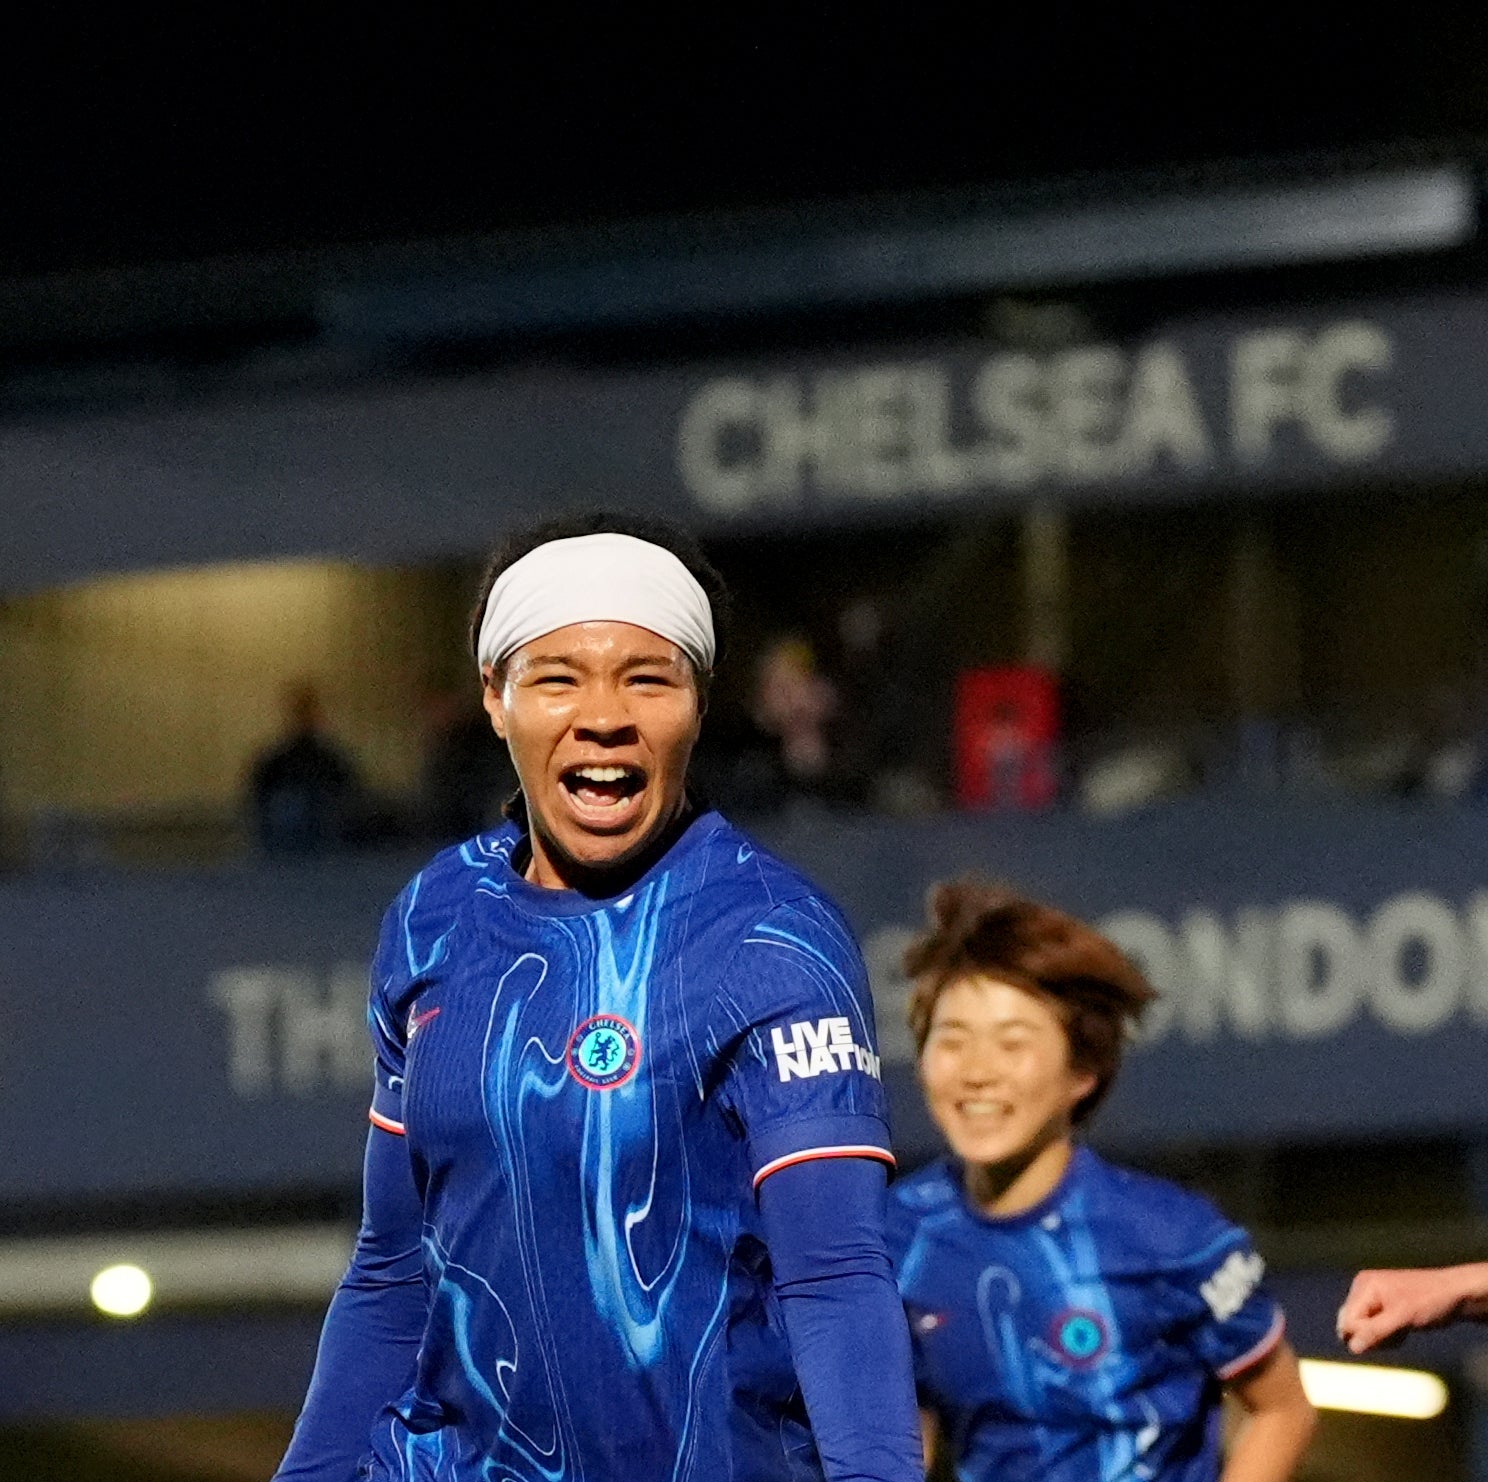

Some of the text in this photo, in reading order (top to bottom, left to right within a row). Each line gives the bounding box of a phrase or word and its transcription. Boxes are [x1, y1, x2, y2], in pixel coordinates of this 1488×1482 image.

[680, 318, 1397, 513] CHELSEA FC
[208, 964, 374, 1096] TH
[771, 1017, 853, 1055] LIVE
